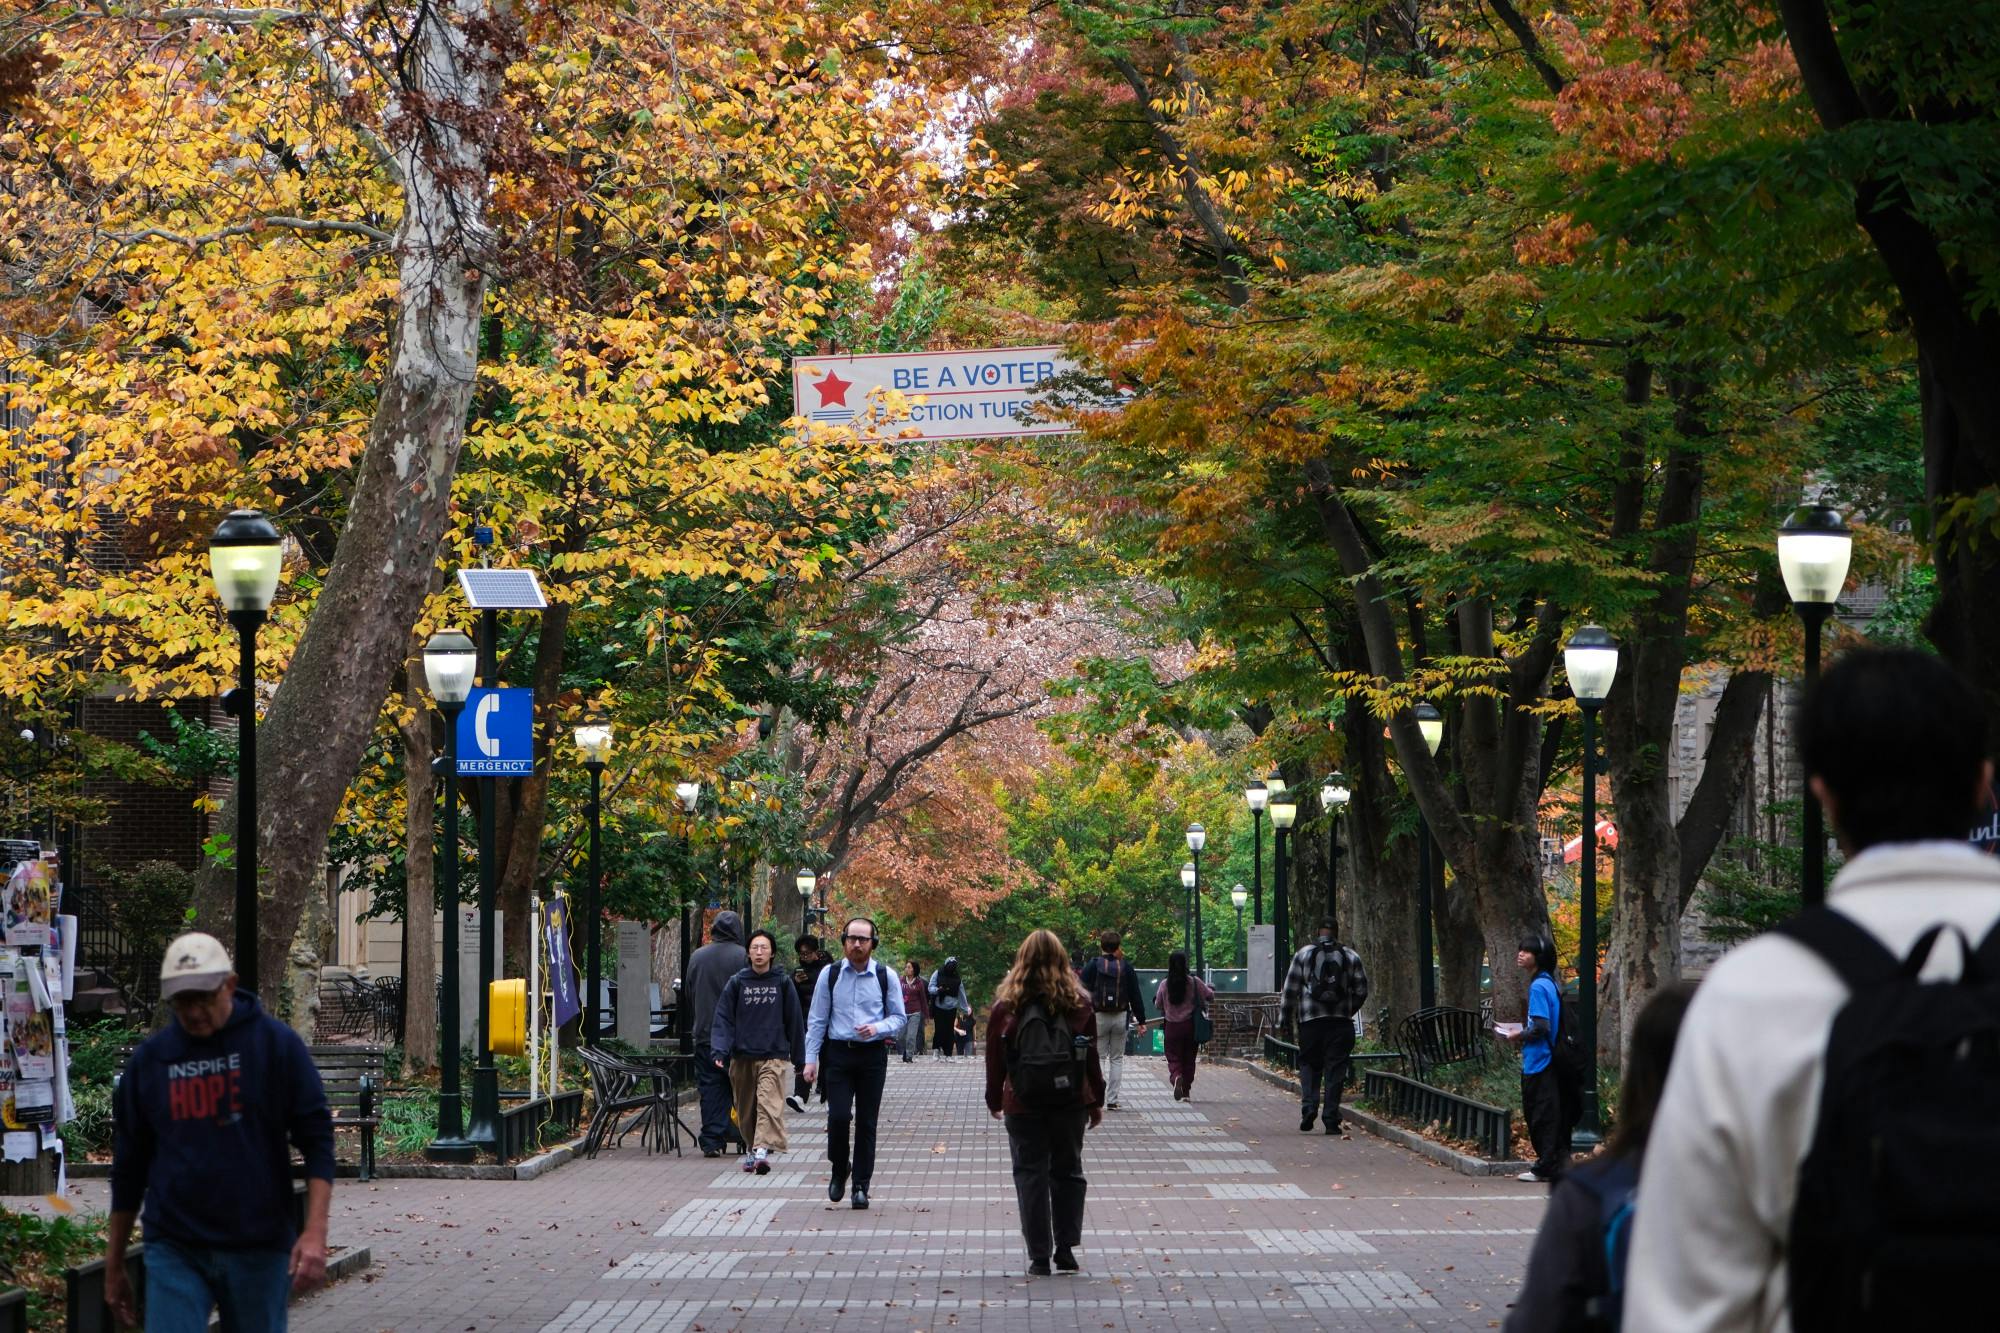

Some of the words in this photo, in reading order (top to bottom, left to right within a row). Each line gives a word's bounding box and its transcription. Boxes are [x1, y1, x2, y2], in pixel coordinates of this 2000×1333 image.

[893, 367, 929, 389] BE
[937, 366, 957, 387] A
[963, 361, 1054, 386] VOTER
[873, 402, 973, 424] ECTION
[457, 762, 526, 771] MERGENCY
[168, 1053, 241, 1079] INSPIRE
[169, 1070, 243, 1121] HOPE
